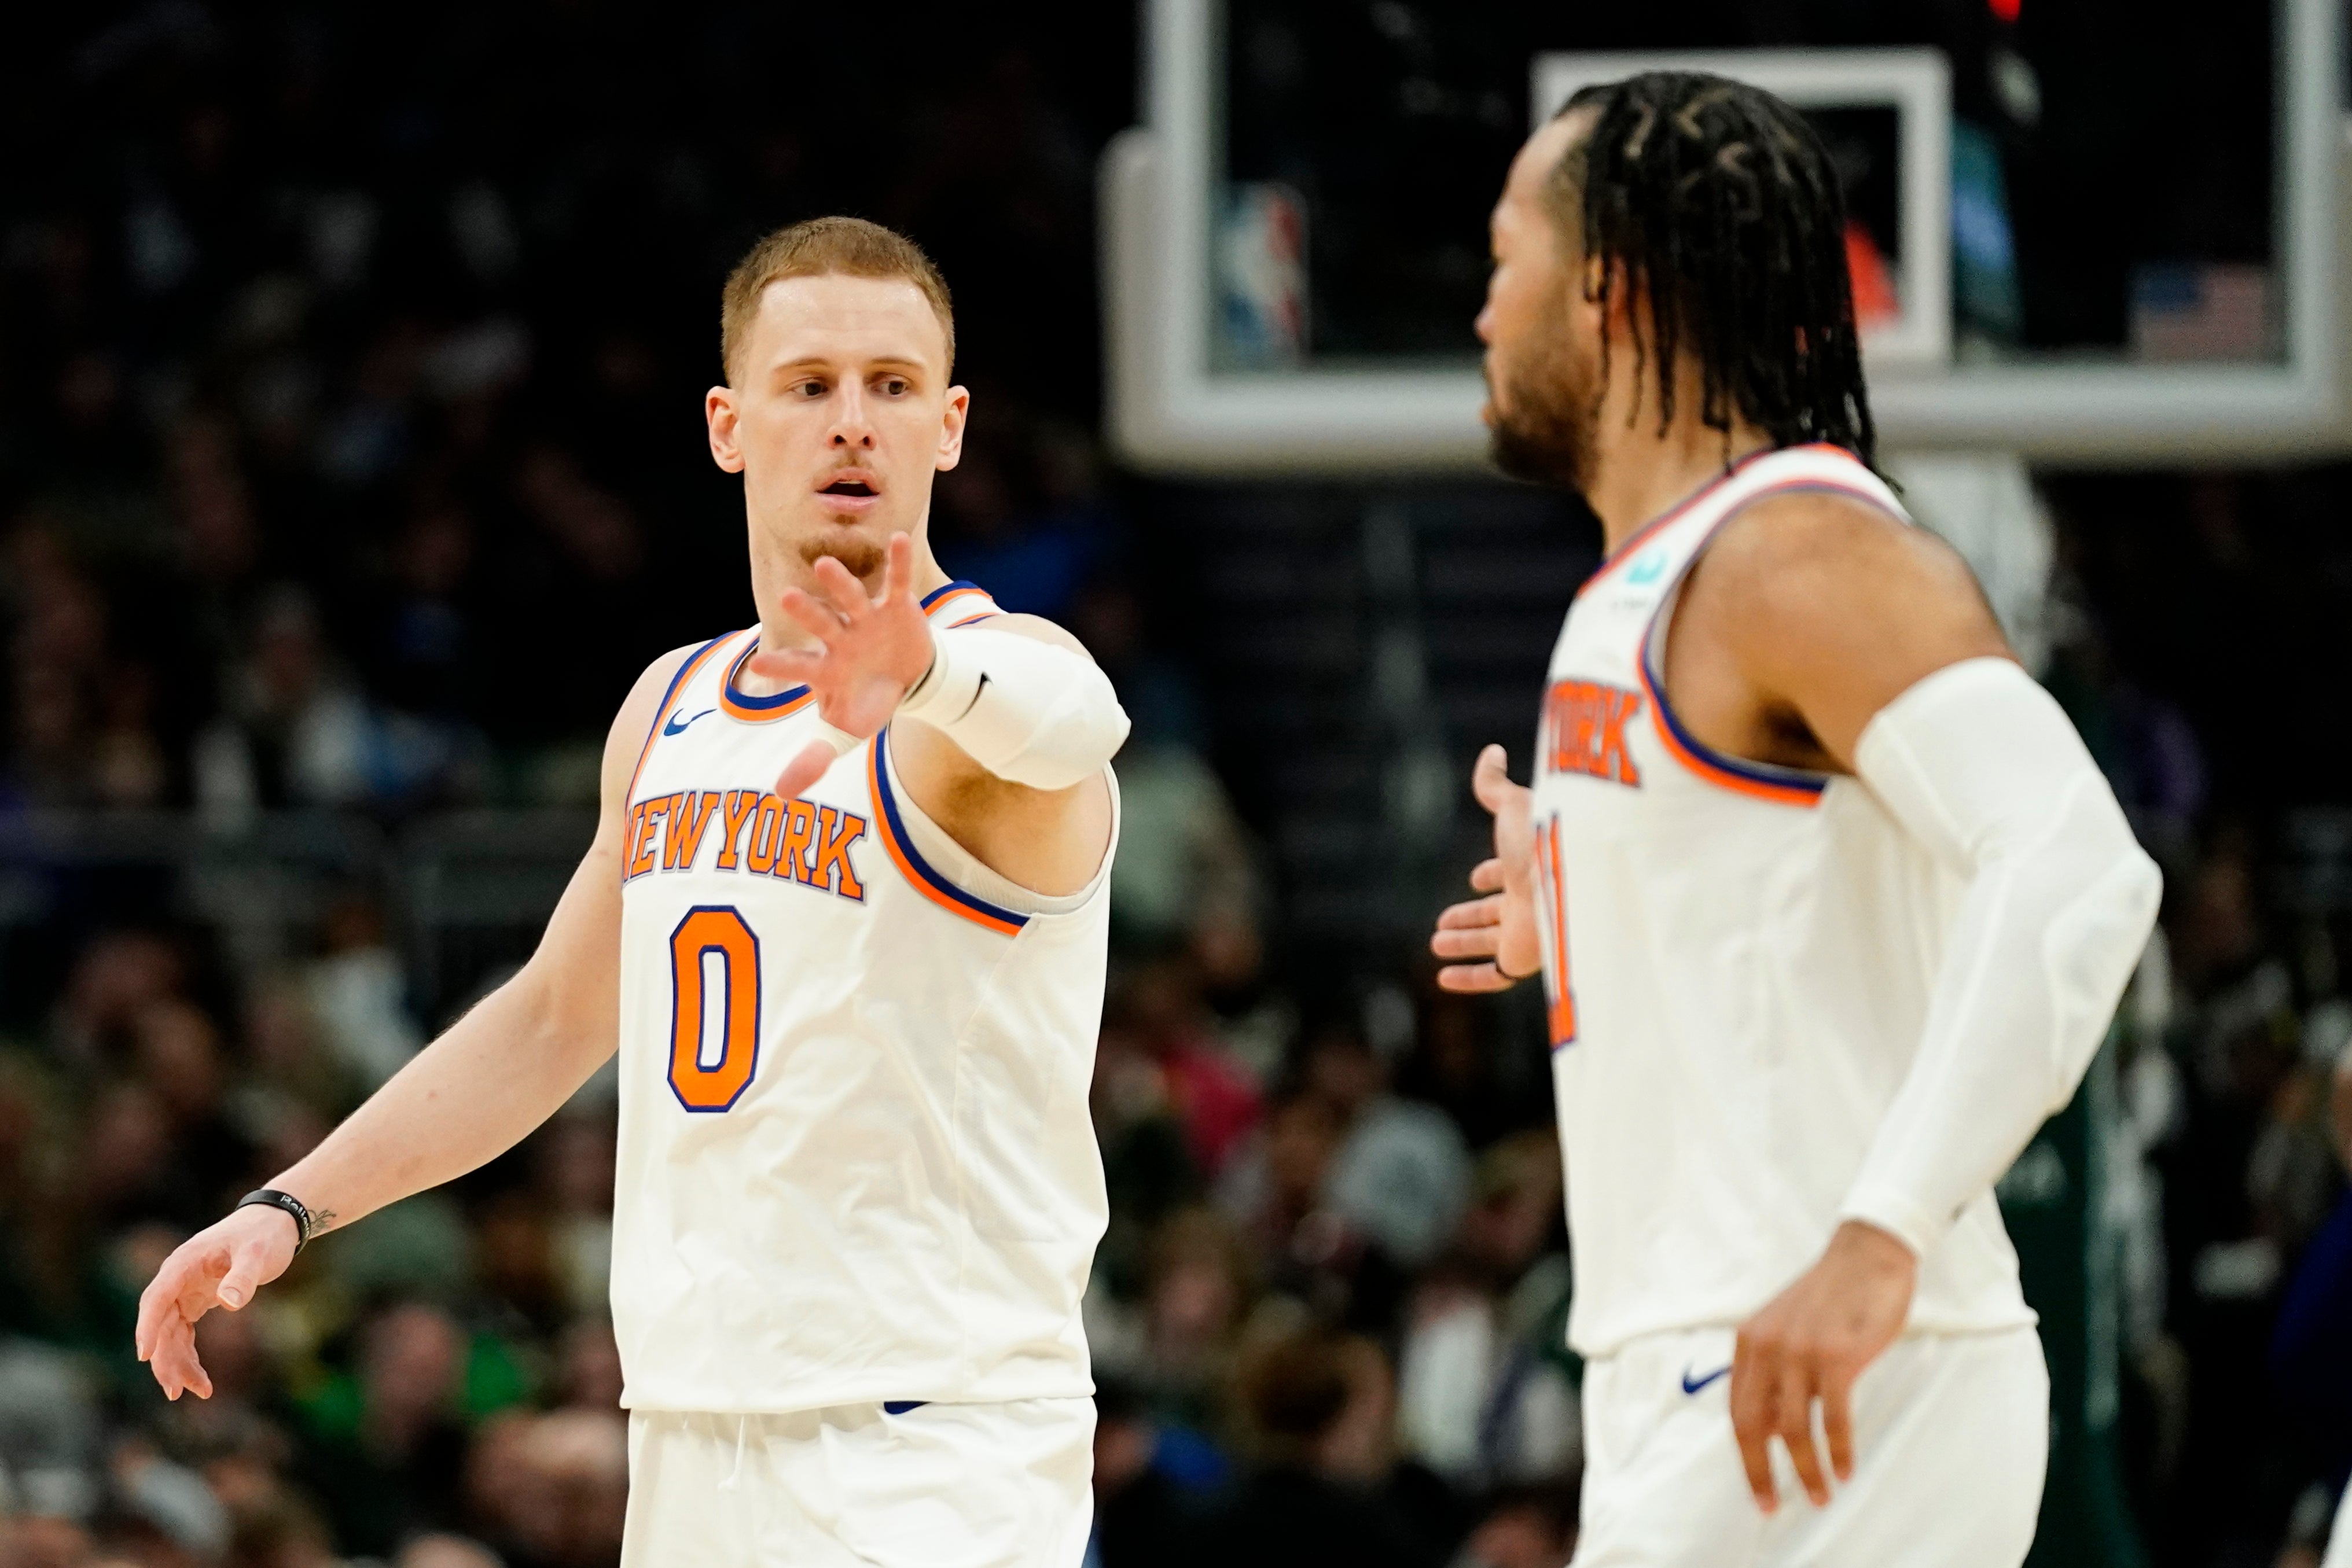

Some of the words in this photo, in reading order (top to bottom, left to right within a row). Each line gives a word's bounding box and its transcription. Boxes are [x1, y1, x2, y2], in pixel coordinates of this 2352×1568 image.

[623, 790, 722, 884] NEW
[715, 789, 870, 905] YORK
[1535, 811, 1578, 1054] 1
[667, 904, 762, 1113] 0
